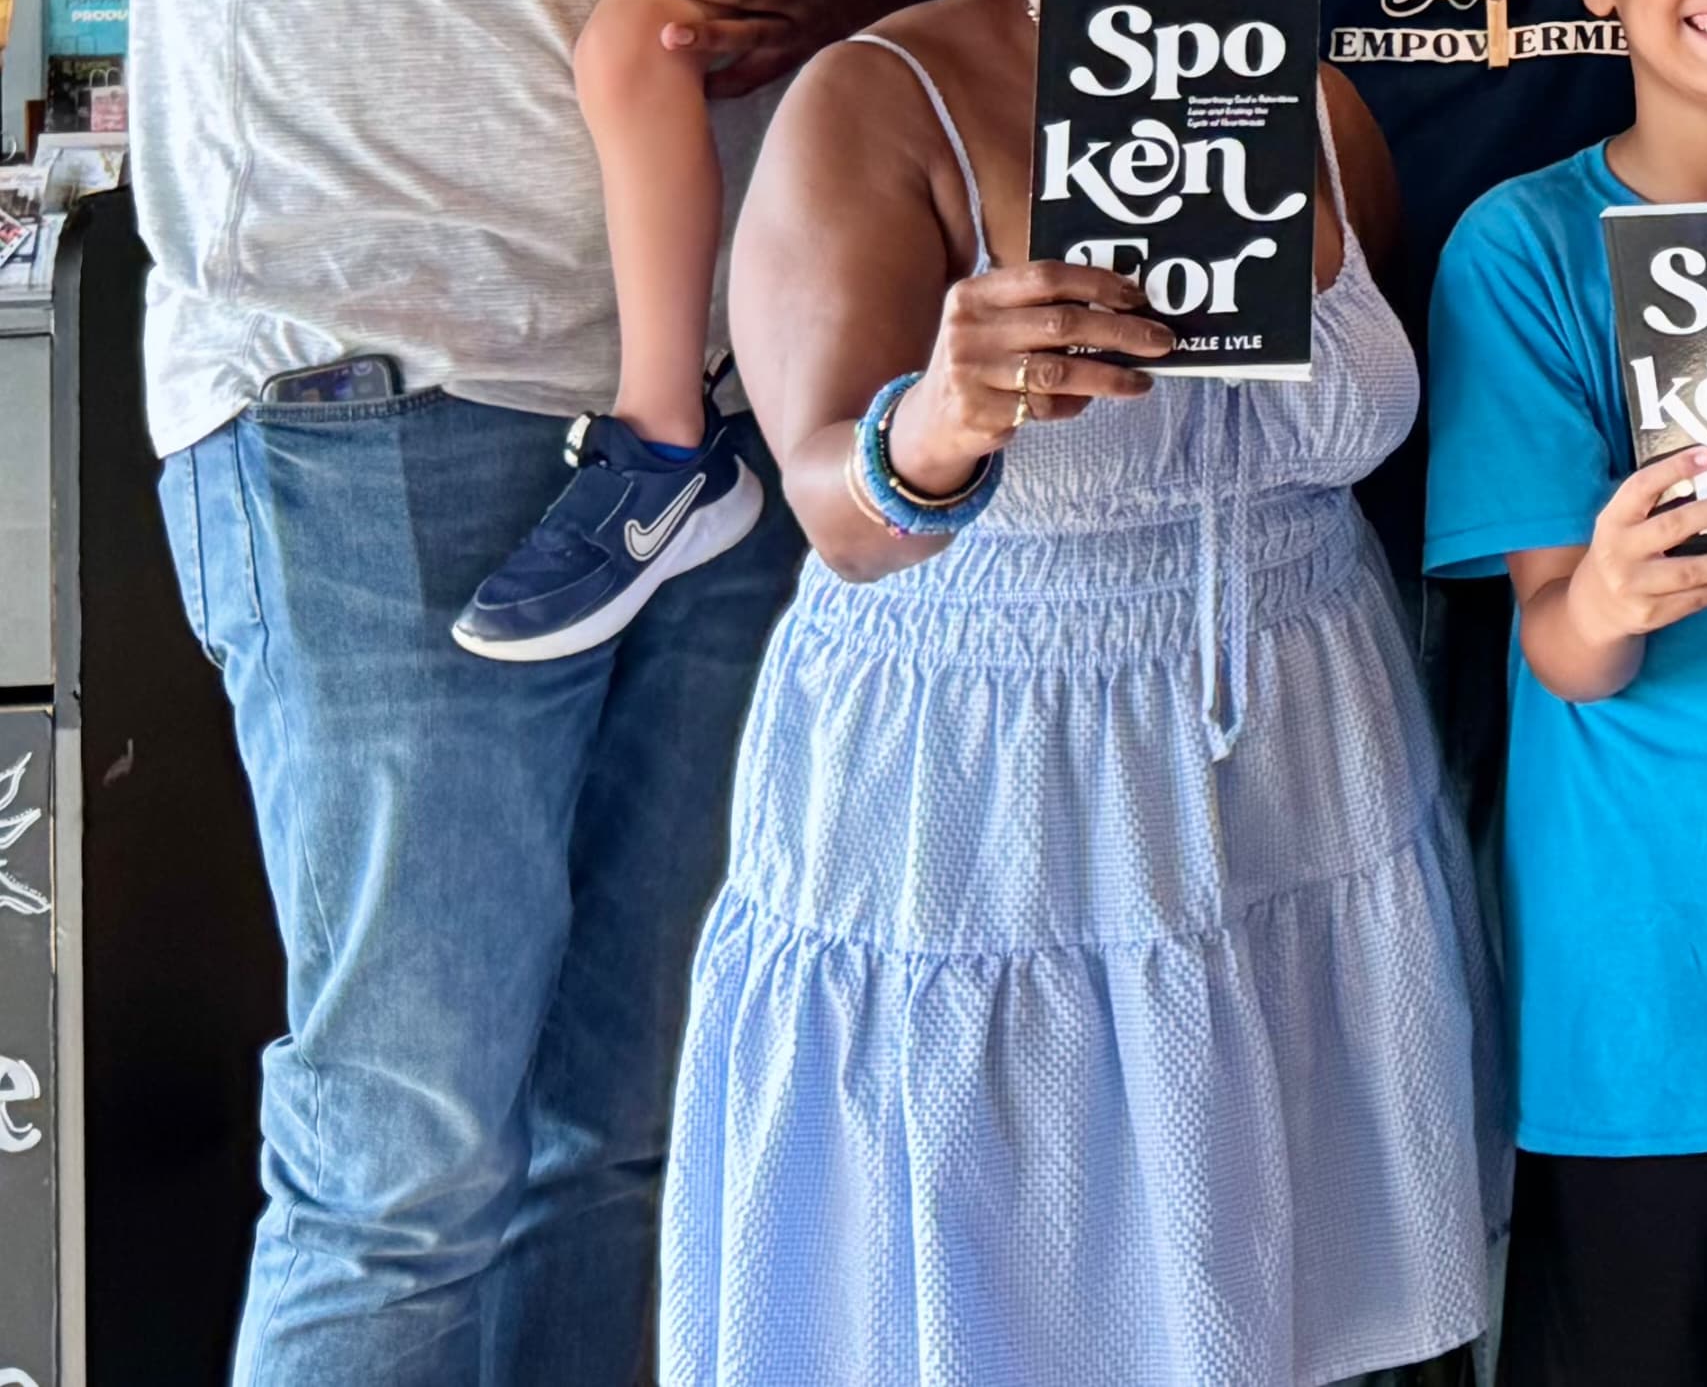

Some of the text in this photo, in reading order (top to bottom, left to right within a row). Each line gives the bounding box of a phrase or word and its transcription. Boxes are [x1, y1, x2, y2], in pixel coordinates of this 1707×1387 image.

[71, 9, 129, 22] PRODU
[1331, 22, 1631, 61] EMPOERME
[1069, 4, 1287, 100] Spo
[1040, 119, 1307, 224] ken
[1065, 238, 1277, 315] For
[1225, 335, 1262, 350] LYLE
